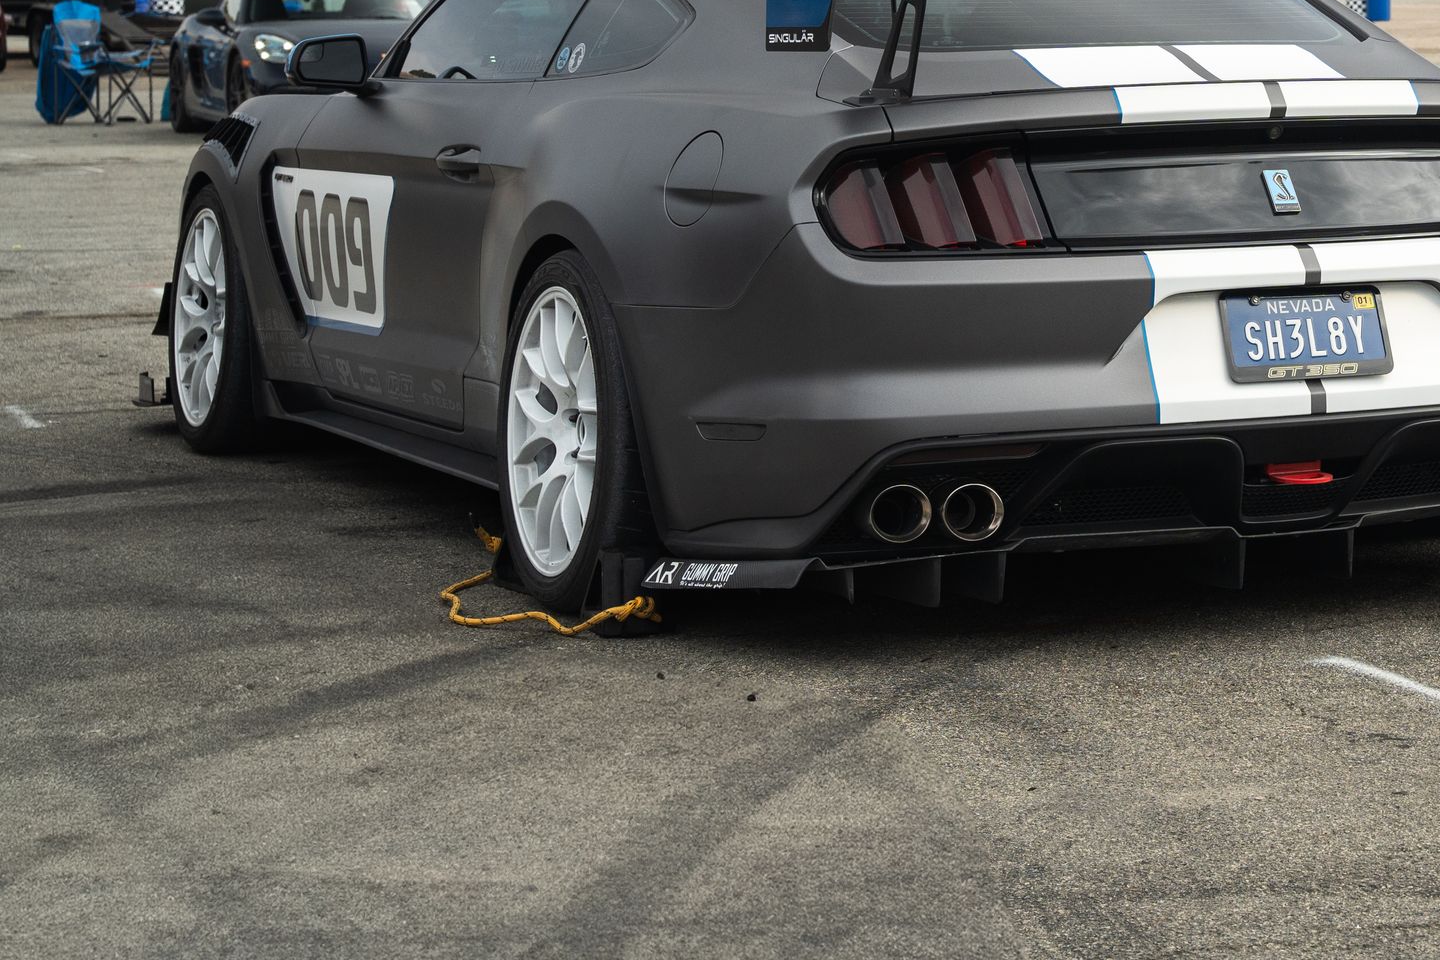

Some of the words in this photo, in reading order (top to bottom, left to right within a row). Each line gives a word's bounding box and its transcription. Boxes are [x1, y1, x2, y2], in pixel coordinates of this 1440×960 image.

[295, 188, 377, 314] 009
[1266, 298, 1335, 315] NEVADA
[1357, 296, 1367, 304] 01
[1245, 315, 1364, 361] SH3L8Y
[681, 563, 718, 581] GUMMY
[712, 563, 739, 582] GRIP
